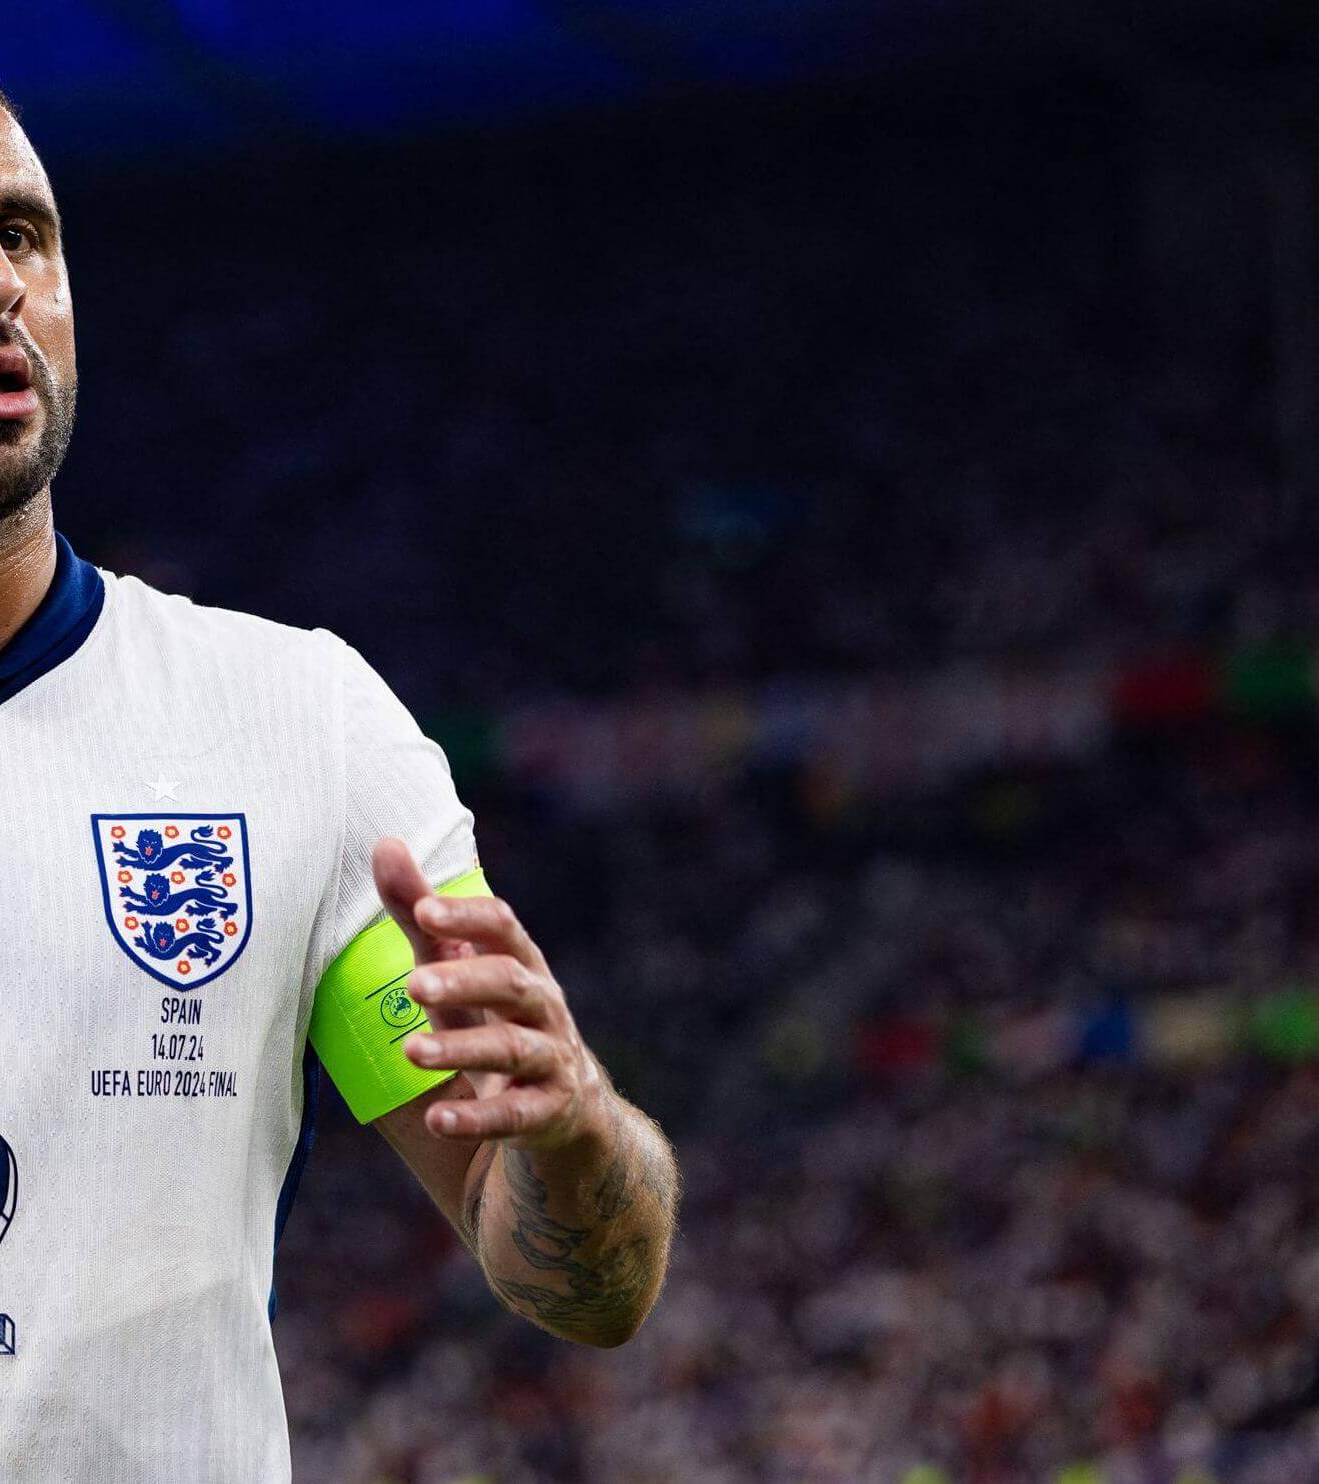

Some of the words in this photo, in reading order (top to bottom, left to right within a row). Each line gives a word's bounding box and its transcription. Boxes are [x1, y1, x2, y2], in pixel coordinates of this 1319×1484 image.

[161, 997, 202, 1024] SPAIN
[385, 990, 405, 1005] UEFA
[152, 1033, 204, 1060] 14.07.24
[91, 1070, 131, 1096] UEFA
[137, 1070, 171, 1096] EURO
[174, 1071, 205, 1097] 2024
[209, 1071, 237, 1097] FINAL
